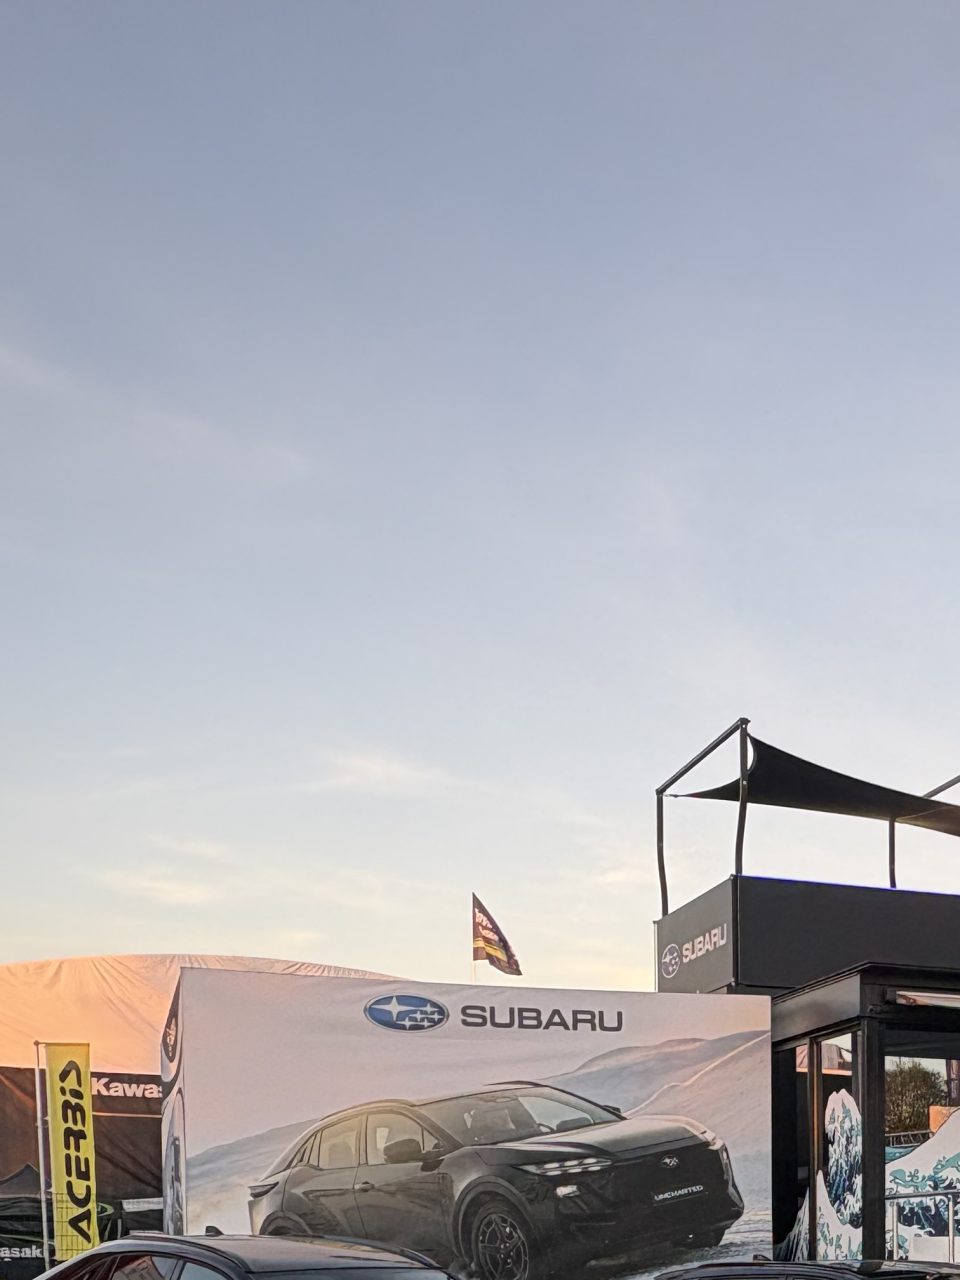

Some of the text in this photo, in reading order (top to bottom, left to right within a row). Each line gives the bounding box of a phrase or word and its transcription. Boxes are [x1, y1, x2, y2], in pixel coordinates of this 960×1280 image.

[681, 923, 727, 963] SUBARU
[460, 1005, 623, 1032] SUBARU
[91, 1077, 163, 1099] Kawa
